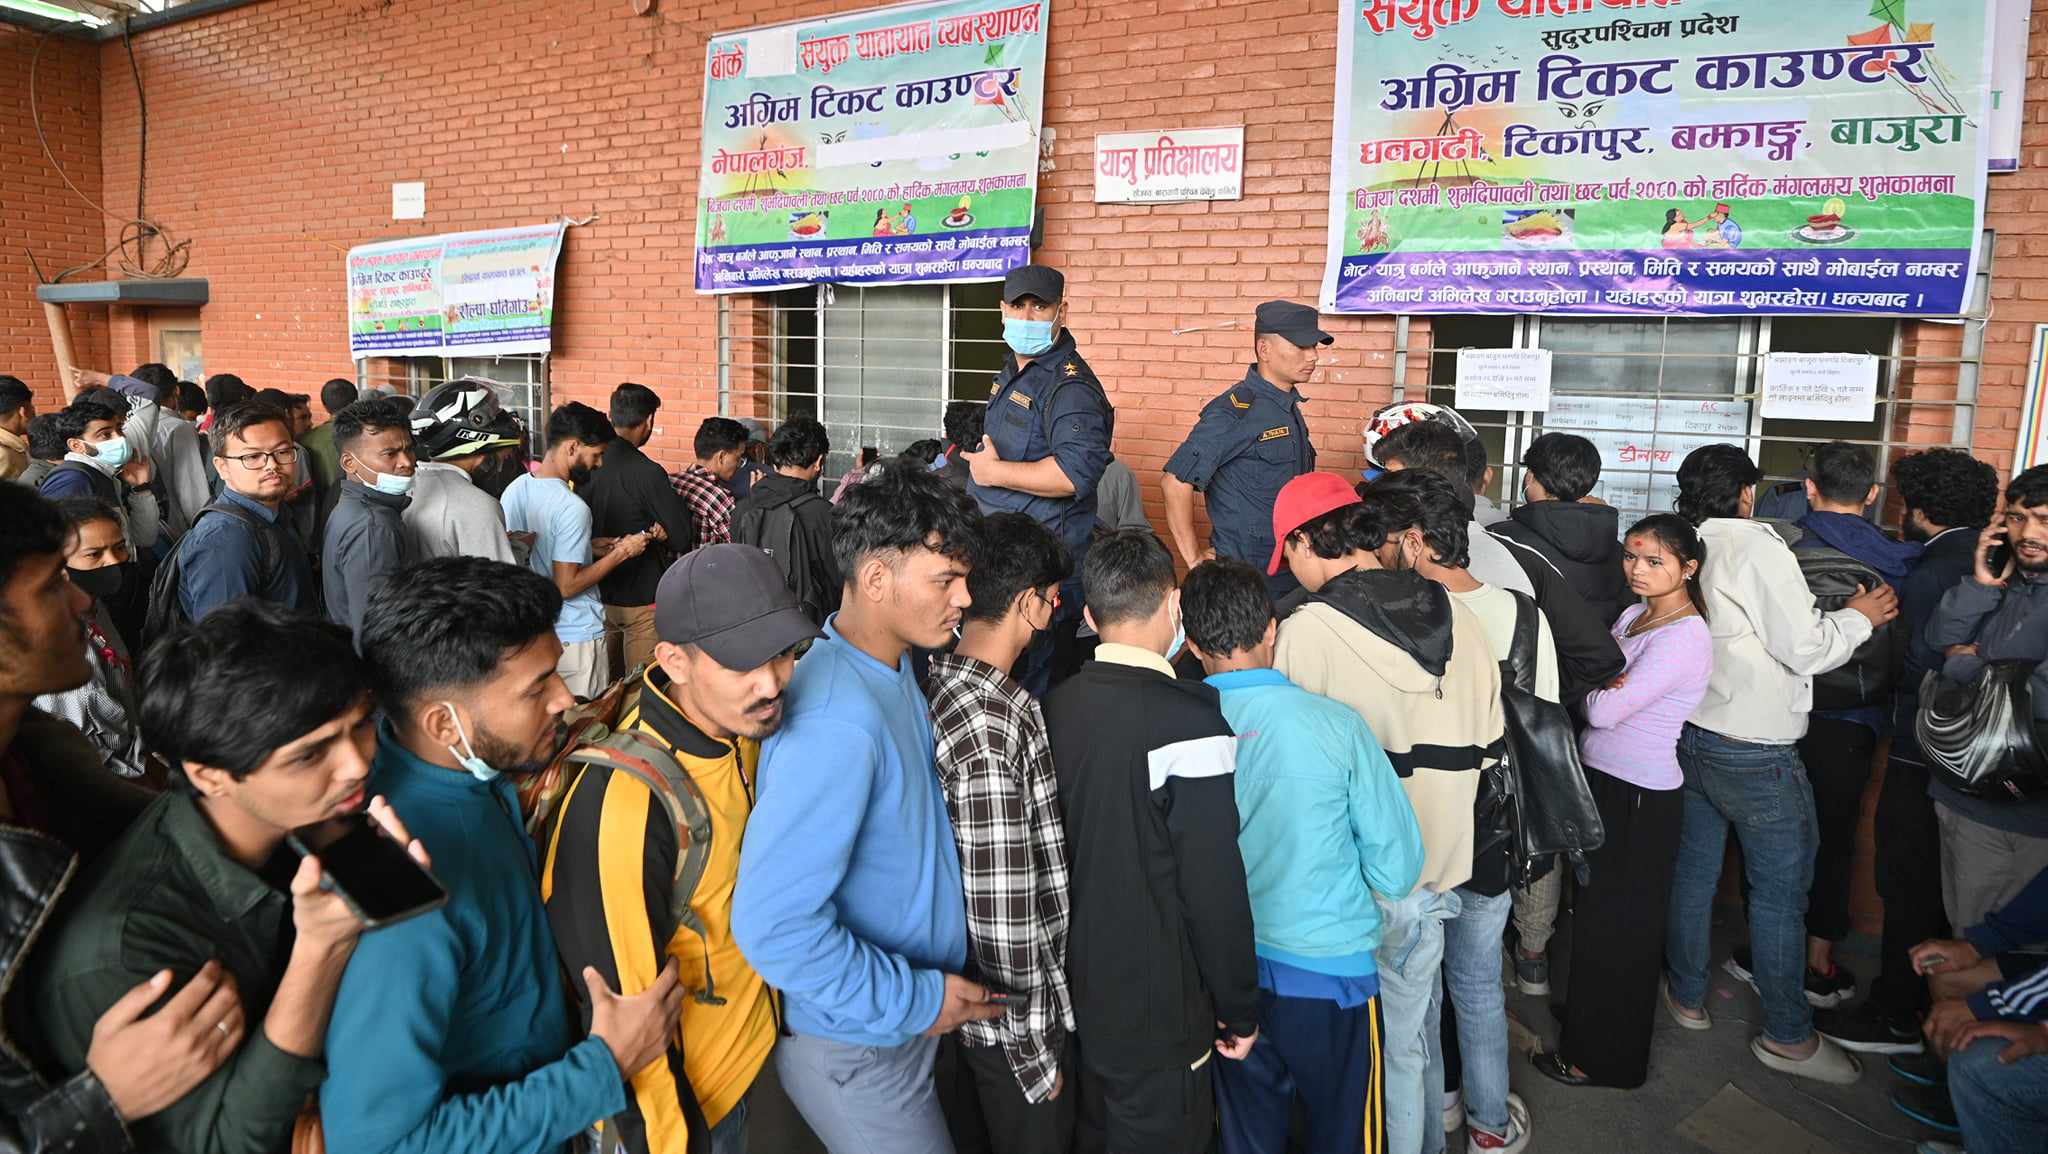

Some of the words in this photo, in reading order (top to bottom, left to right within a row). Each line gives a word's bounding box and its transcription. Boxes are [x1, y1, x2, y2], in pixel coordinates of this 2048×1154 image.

[800, 35, 850, 74] संयुक्त
[855, 21, 931, 60] यातायात
[1541, 19, 1672, 50] सुदुरपश्चिम
[1680, 13, 1739, 38] प्रदेश
[1380, 63, 1521, 111] अग्रिम
[1537, 54, 1679, 101] टिकट
[1695, 42, 1935, 92] काउण्टर
[724, 93, 801, 128] अग्रिम
[810, 86, 886, 120] टिकट
[895, 67, 1021, 109] काउण्टर
[1830, 115, 1967, 152] बाजुरा
[1100, 149, 1138, 185] यात्रु
[1144, 135, 1239, 180] प्रतिक्षालय
[811, 193, 827, 208] तथा
[861, 188, 883, 202] २०८०
[887, 184, 900, 200] को
[902, 181, 932, 200] हार्दिक
[978, 173, 1028, 195] शुभकामना
[1539, 183, 1570, 202] तथा
[1608, 177, 1632, 199] पर्व
[1635, 181, 1677, 198] २०८०
[1683, 175, 1708, 199] को
[1711, 173, 1768, 199] हार्दिक
[1772, 174, 1854, 196] मंगलमय
[1858, 174, 1956, 201] शुभकामना
[885, 243, 892, 255] र
[894, 238, 932, 255] समयको
[888, 263, 912, 275] यात्रा
[1376, 263, 1407, 279] यात्रु
[1643, 257, 1682, 277] मिति
[1688, 261, 1700, 277] र
[1704, 257, 1777, 277] समयको
[1781, 257, 1821, 277] साथै
[1825, 258, 1899, 279] मोबाईल
[1905, 262, 1963, 278] नम्बर
[1428, 285, 1491, 304] अभिलेख
[1694, 290, 1736, 305] यात्रा
